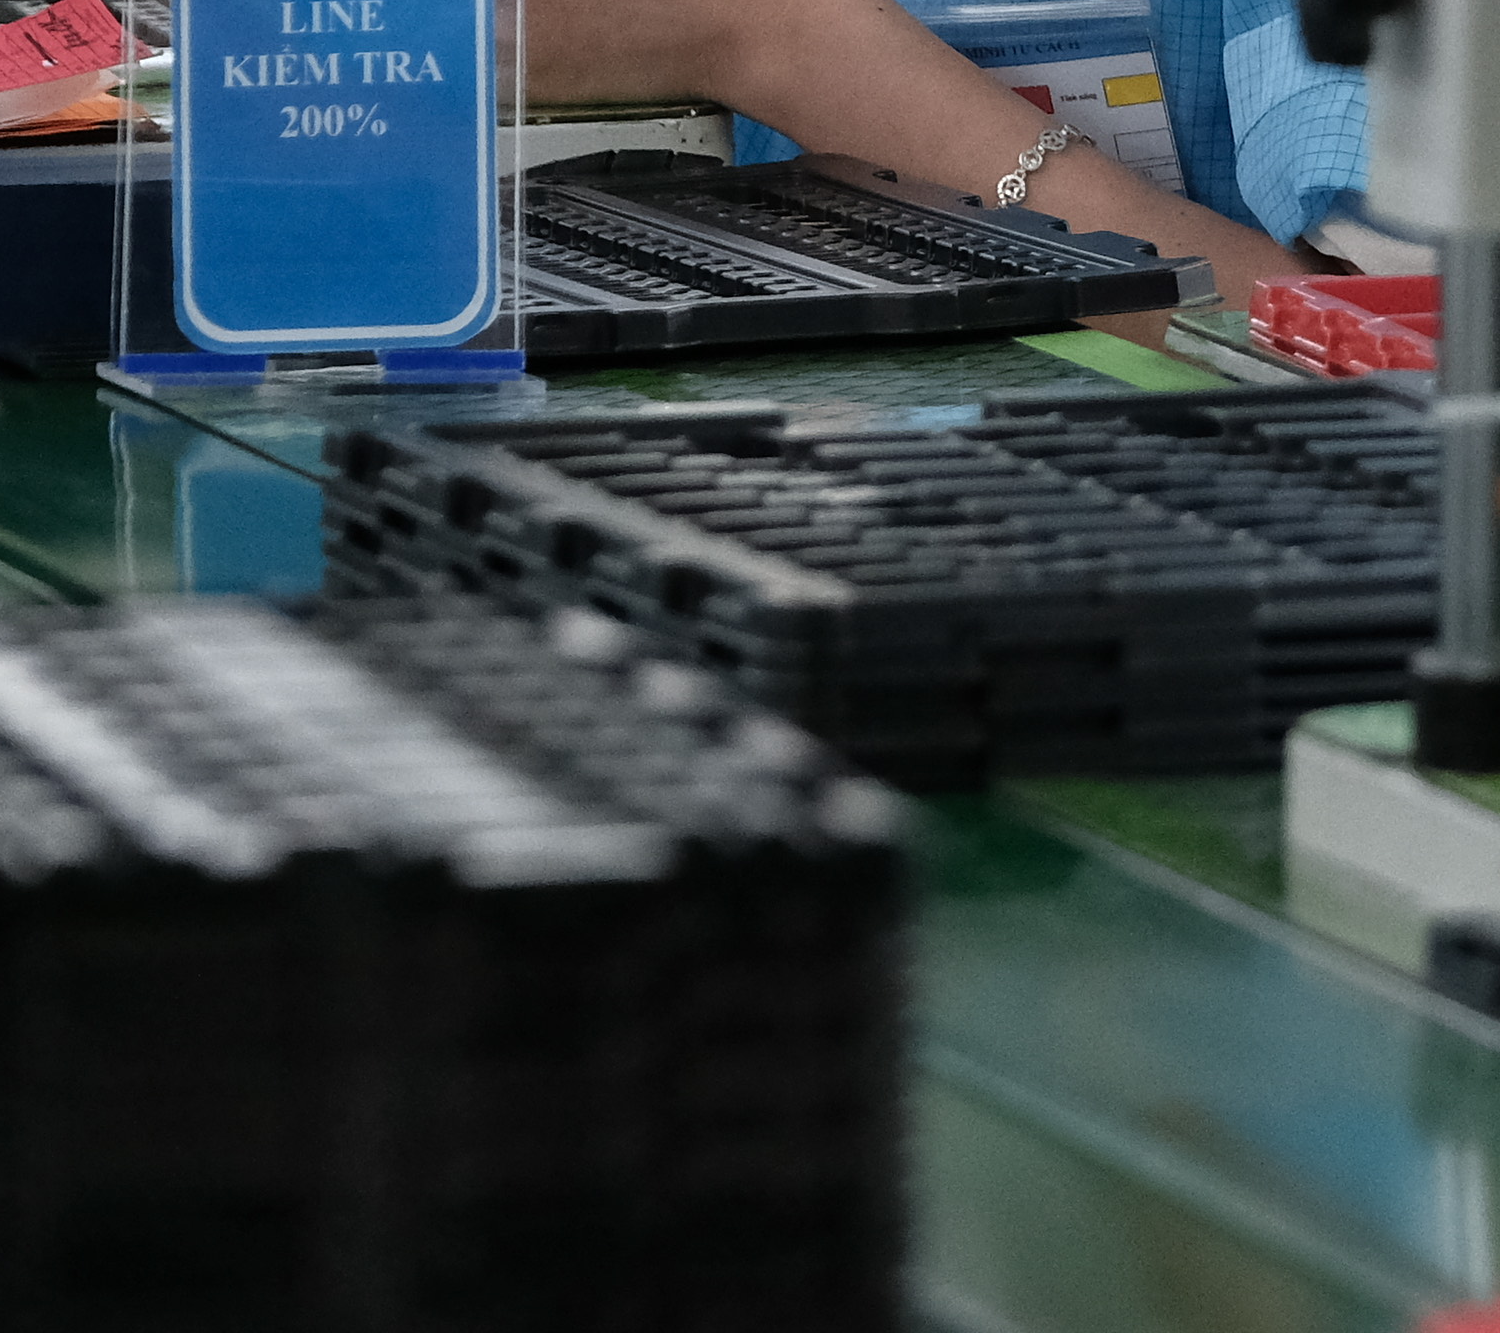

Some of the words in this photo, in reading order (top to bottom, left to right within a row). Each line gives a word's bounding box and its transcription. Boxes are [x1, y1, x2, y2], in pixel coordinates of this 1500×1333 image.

[280, 0, 385, 34] LINE
[223, 43, 341, 88] KIỂM
[353, 50, 444, 83] TRA
[279, 103, 387, 138] 200%
